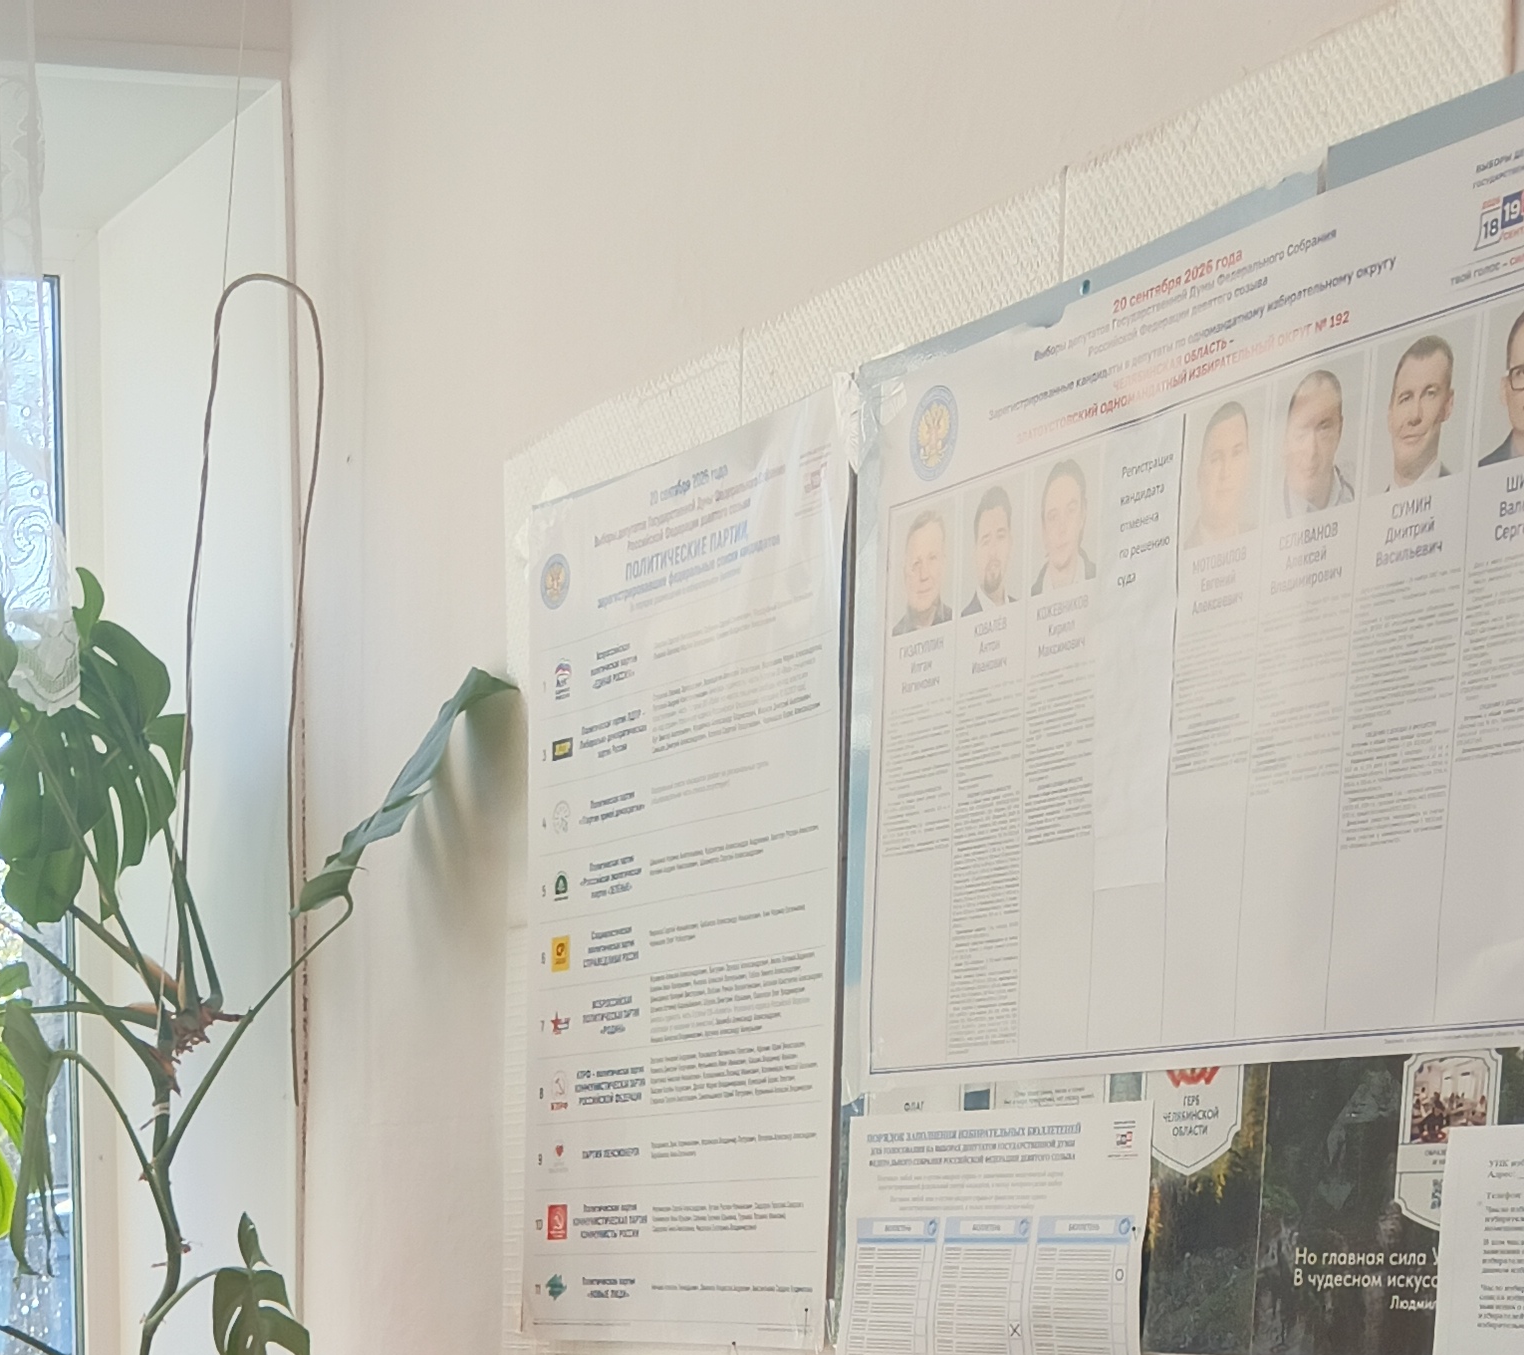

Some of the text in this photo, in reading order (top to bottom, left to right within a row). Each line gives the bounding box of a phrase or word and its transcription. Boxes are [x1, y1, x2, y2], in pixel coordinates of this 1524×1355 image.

[1483, 200, 1520, 239] 18 19
[1112, 250, 1243, 314] 20 сентября 2026 года
[1451, 262, 1500, 286] ТВОЙ ГОЛОС
[1034, 229, 1336, 362] Выборы депутатов Государственной Думы Федерального Собрания
[1088, 276, 1268, 357] Российской Федерации девятого созыва
[988, 381, 1074, 421] Зарегистрированные
[1076, 364, 1123, 388] кандидаты
[1132, 345, 1174, 368] депутаты
[1176, 339, 1186, 351] по
[1188, 305, 1265, 343] одномандатному
[1267, 272, 1354, 312] избирательному
[1356, 256, 1396, 280] округу
[1100, 371, 1187, 414] ОДНОМАНДАТНЫЙ
[1188, 335, 1275, 382] ИЗБИРАТЕЛЬНЫЙ
[1277, 324, 1312, 347] ОКРУГ
[1314, 319, 1328, 336] №
[1330, 311, 1350, 330] 192
[1112, 339, 1227, 392] ЧЕЛЯБИНСКАЯ ОБЛАСТЬ
[1122, 452, 1174, 479] Регистрация
[1120, 482, 1165, 507] кандидата
[1392, 495, 1432, 520] СУМИН
[1120, 511, 1160, 532] отменена
[1385, 516, 1436, 544] Дмитрий
[1119, 536, 1170, 559] по решению
[1279, 521, 1339, 551] СЕЛИВАНОВ
[626, 535, 707, 581] ПОЛИТИЧЕСКИЕ
[1192, 546, 1247, 575] МОТОВИЛОВ
[1285, 547, 1327, 570] Алексей
[1375, 539, 1443, 568] Васильевич
[1117, 572, 1136, 588] суда
[1201, 569, 1236, 593] Евгений
[1270, 566, 1343, 596] Владимирович
[1036, 594, 1089, 622] КОЖЕВНИКОВ
[1192, 592, 1243, 616] Алексеевич
[1048, 619, 1076, 638] Кирилл
[1037, 636, 1086, 659] Максимович
[904, 1100, 924, 1112] ФЛАГ
[1184, 1095, 1200, 1106] ГЕРБ
[1163, 1106, 1219, 1123] ЧЕЛЯБИНСКОЙ
[1172, 1125, 1208, 1136] ОБЛАСТИ
[1295, 1247, 1426, 1266] Но главная сила
[1293, 1268, 1303, 1286] В
[1307, 1272, 1382, 1291] чудесном
